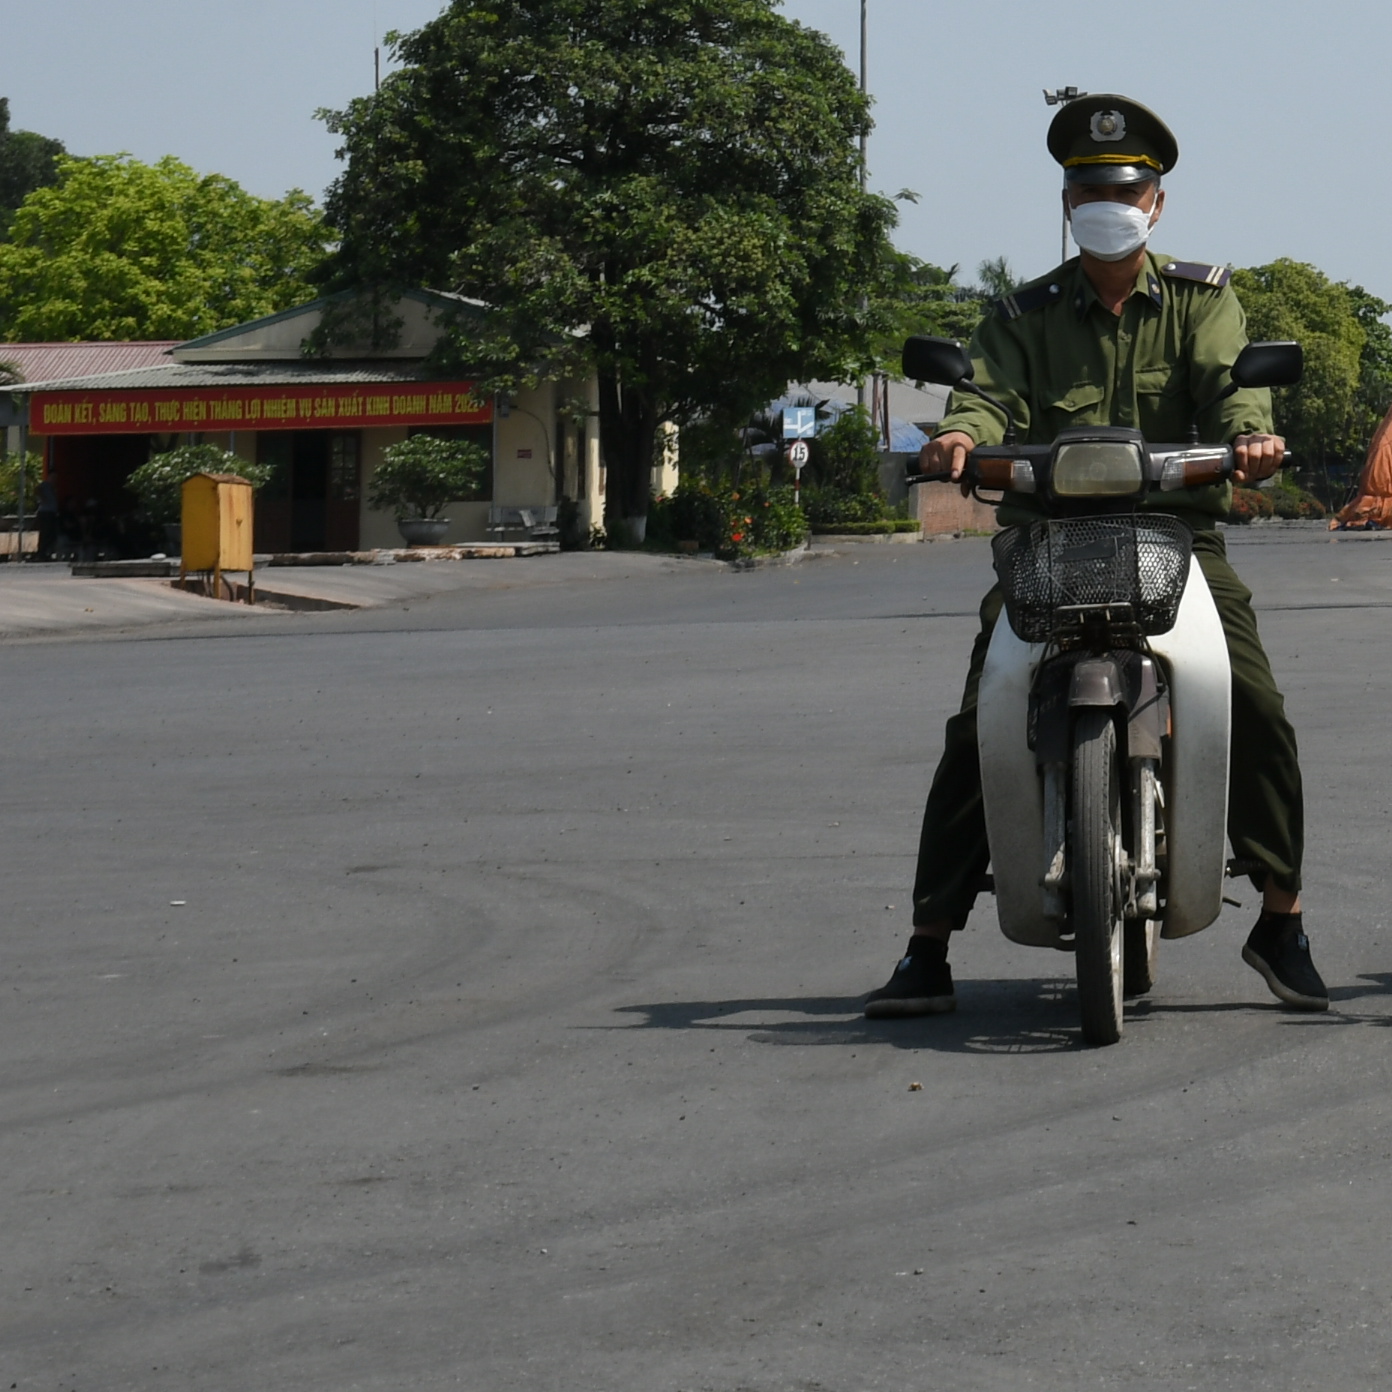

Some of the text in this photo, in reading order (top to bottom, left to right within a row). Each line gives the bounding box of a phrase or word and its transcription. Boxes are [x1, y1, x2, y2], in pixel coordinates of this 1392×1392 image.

[99, 399, 127, 423] SÁNG
[130, 402, 152, 427] TẠO,
[154, 398, 180, 425] THỰC
[183, 396, 207, 425] HIỆN
[245, 399, 261, 424] LỢI
[300, 398, 312, 423] VỤ
[314, 389, 335, 418] SẢN
[337, 390, 364, 417] XUẤT
[366, 395, 390, 416] KINH
[392, 394, 426, 416] DOANH
[429, 390, 452, 414] NĂM
[793, 445, 805, 461] 15
